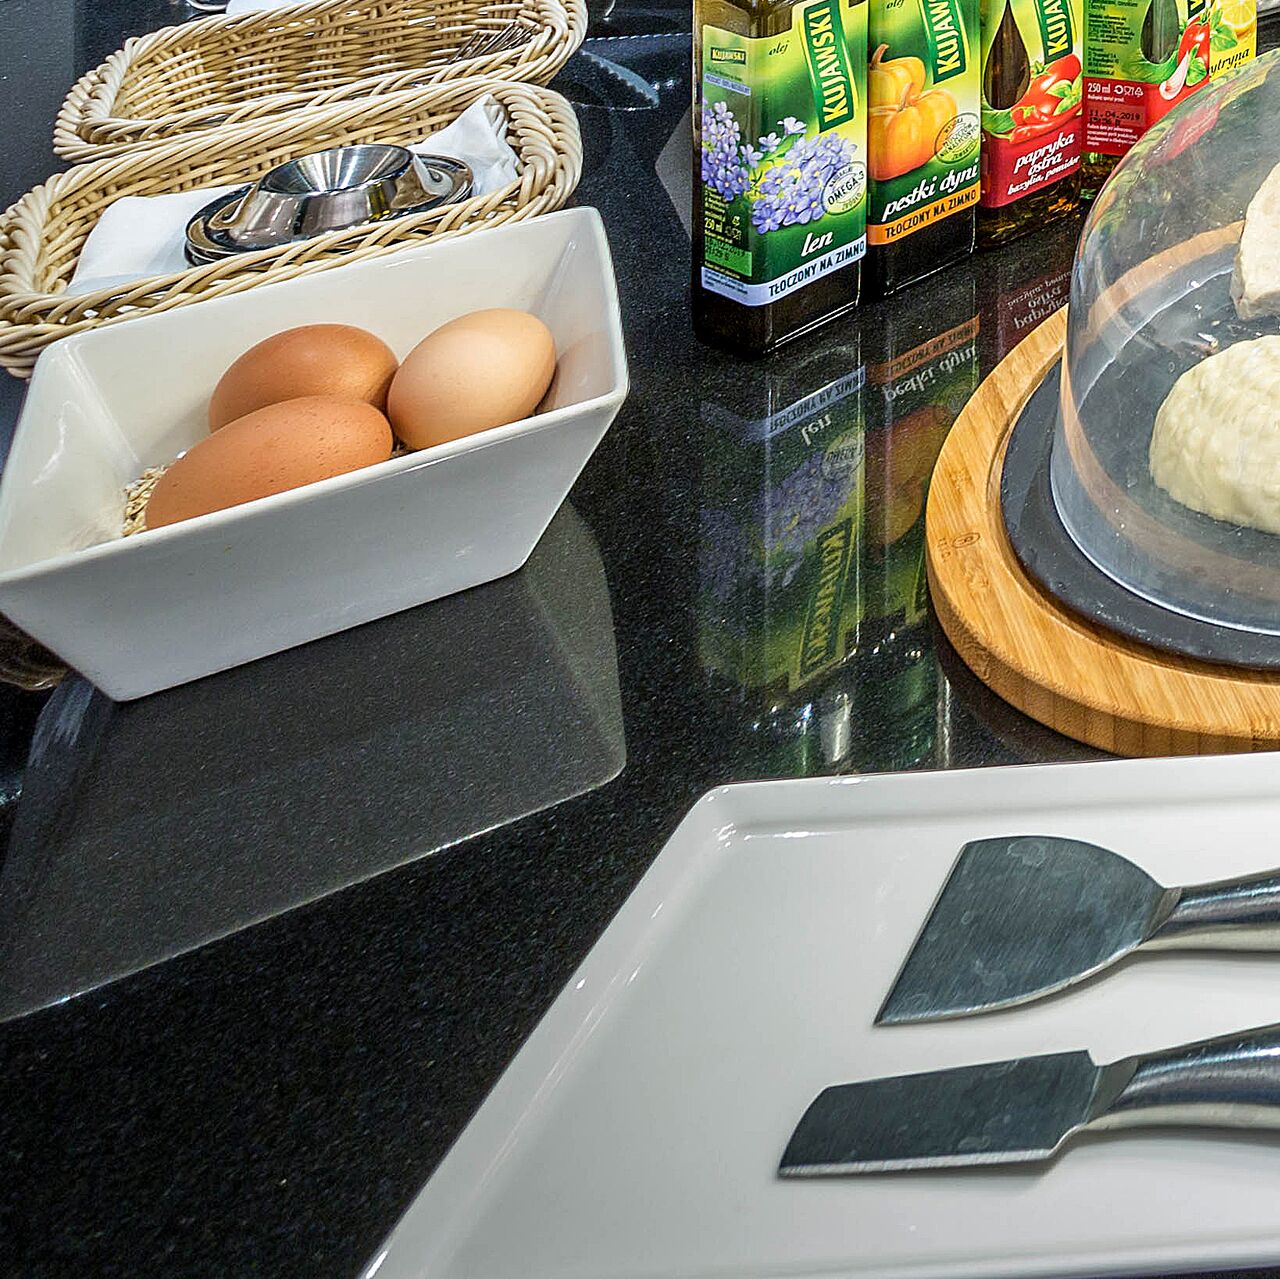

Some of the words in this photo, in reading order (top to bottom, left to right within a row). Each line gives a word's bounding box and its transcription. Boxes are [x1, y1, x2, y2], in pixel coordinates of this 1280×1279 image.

[768, 40, 791, 56] olej
[808, 6, 849, 123] KUJAWSKI
[1209, 48, 1251, 77] ytryna
[1087, 83, 1101, 94] 250
[1101, 83, 1111, 94] ml
[1013, 132, 1075, 174] papryka
[1028, 152, 1063, 177] ostra
[881, 175, 938, 222] pestki
[939, 158, 979, 193] dyni
[1007, 173, 1044, 195] bazylia,
[1044, 155, 1080, 180] pomidor
[884, 207, 931, 239] TŁOCZONY
[933, 202, 946, 217] NA
[948, 189, 977, 209] ZIMNO
[801, 231, 833, 257] len
[768, 264, 817, 297] TŁOCZONY
[819, 257, 833, 273] NA
[835, 240, 865, 265] ZIMNO
